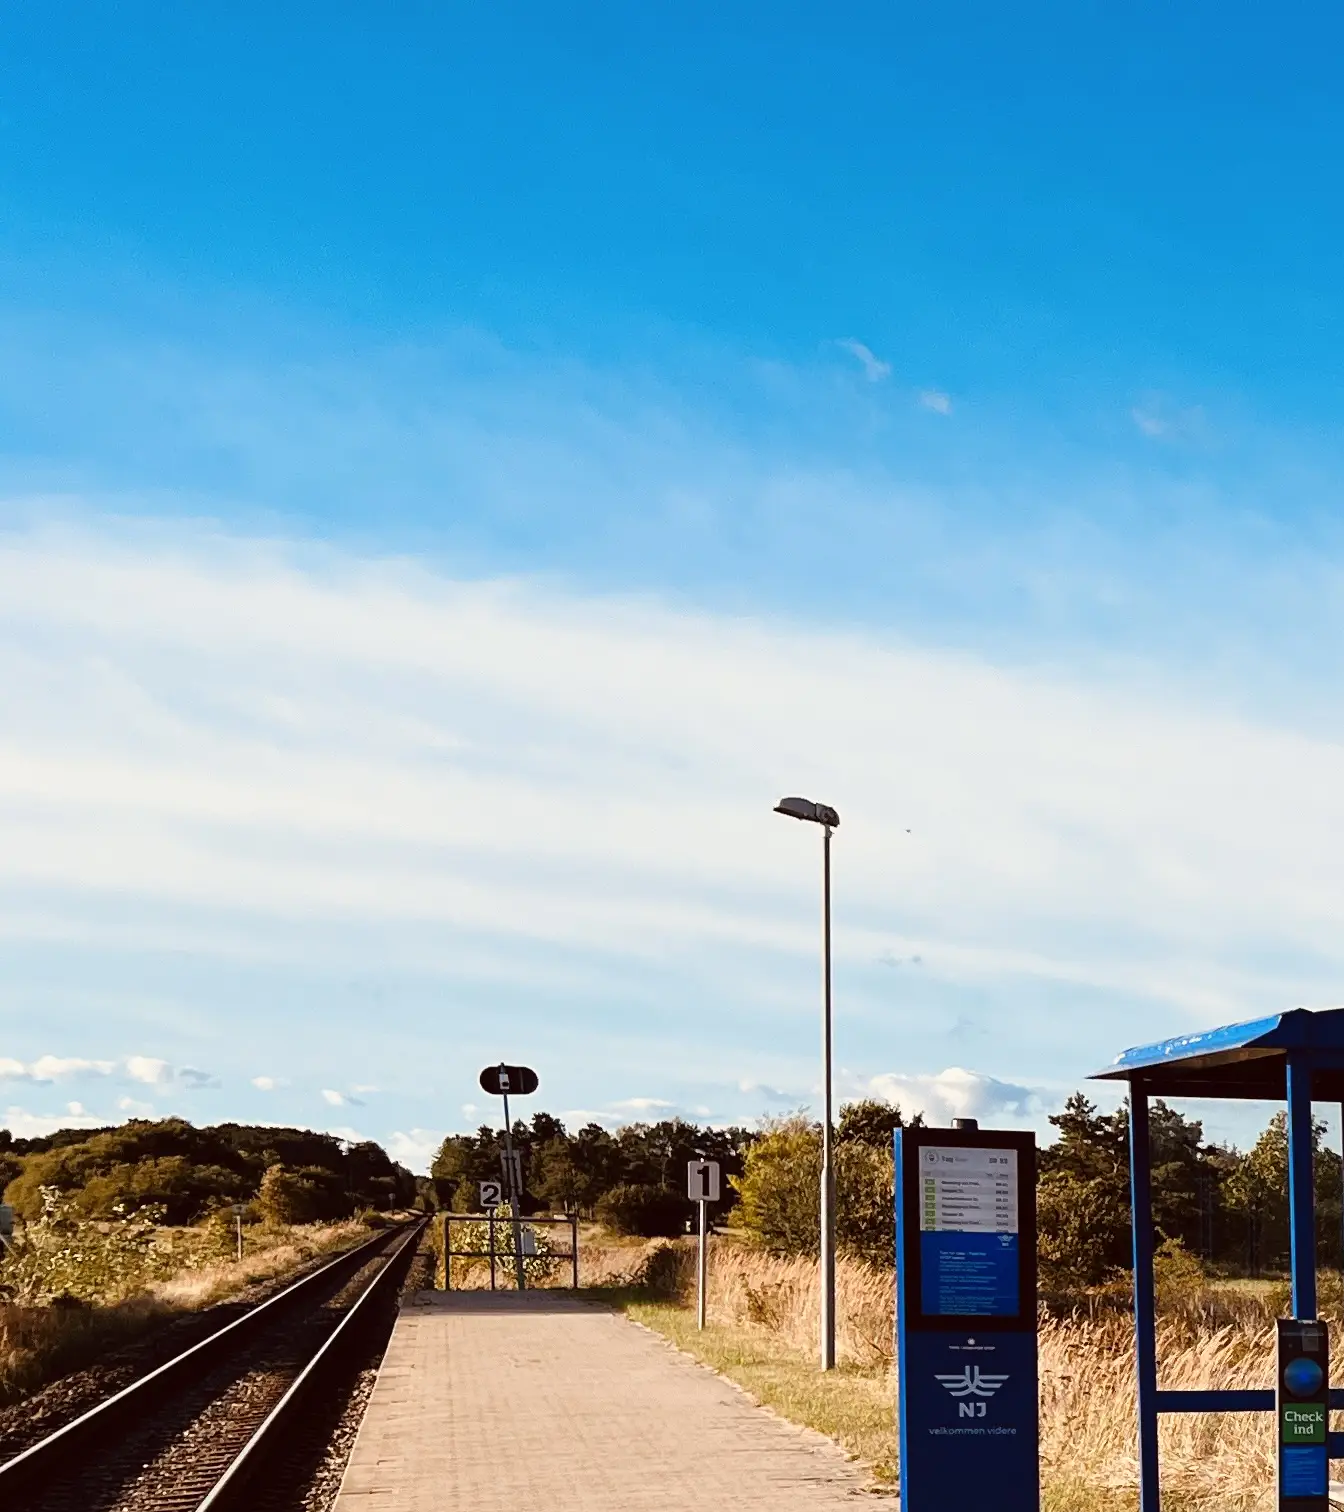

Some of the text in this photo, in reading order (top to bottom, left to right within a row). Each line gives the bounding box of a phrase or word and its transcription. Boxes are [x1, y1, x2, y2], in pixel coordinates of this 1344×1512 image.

[697, 1166, 710, 1197] 1
[482, 1185, 499, 1205] 2
[959, 1402, 987, 1418] NJ
[1284, 1410, 1324, 1422] Check
[928, 1426, 1017, 1435] velkommen videre
[1293, 1423, 1314, 1435] ind
